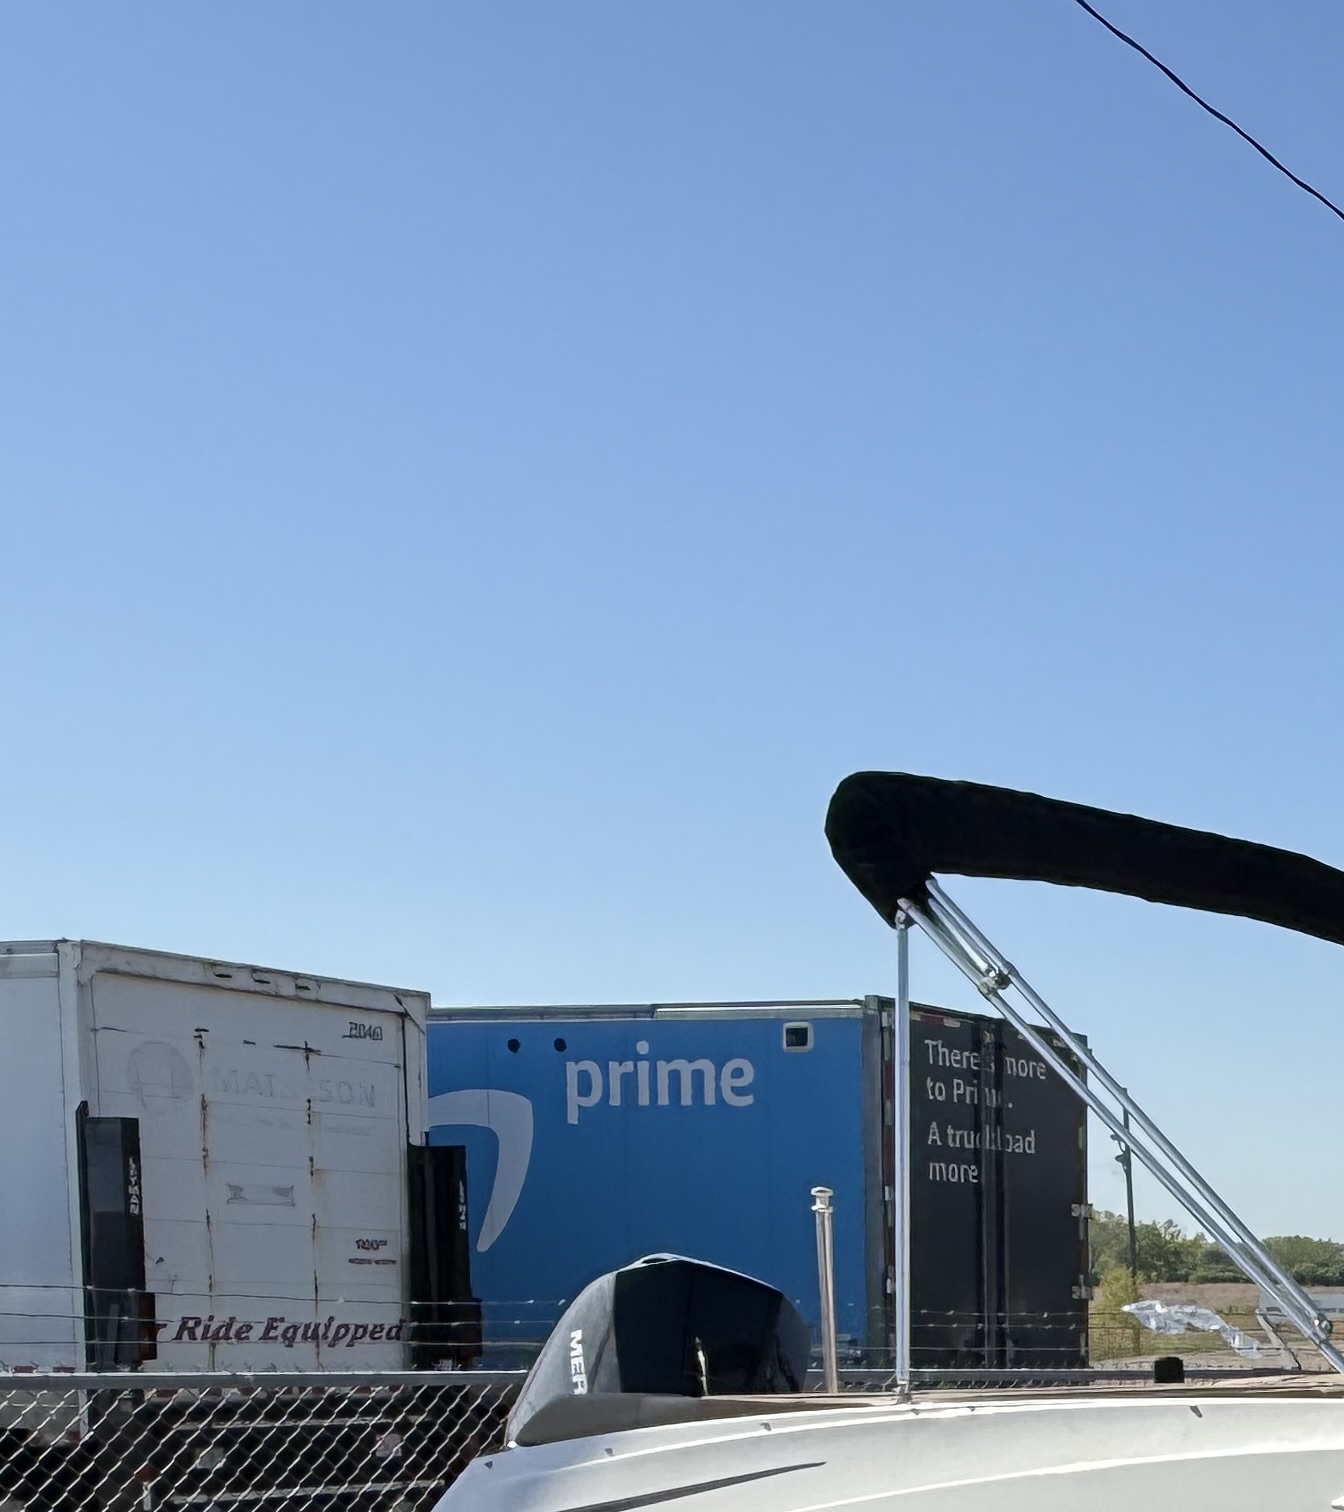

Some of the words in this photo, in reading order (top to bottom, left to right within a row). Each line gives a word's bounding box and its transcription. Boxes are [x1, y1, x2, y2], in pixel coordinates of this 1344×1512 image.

[925, 1039, 996, 1073] Theres
[565, 1040, 755, 1125] prime
[926, 1076, 946, 1102] to
[952, 1078, 1014, 1109] Prim.
[927, 1121, 943, 1146] A
[928, 1161, 979, 1184] more
[172, 1314, 254, 1342] Ride
[258, 1315, 407, 1348] Equipped
